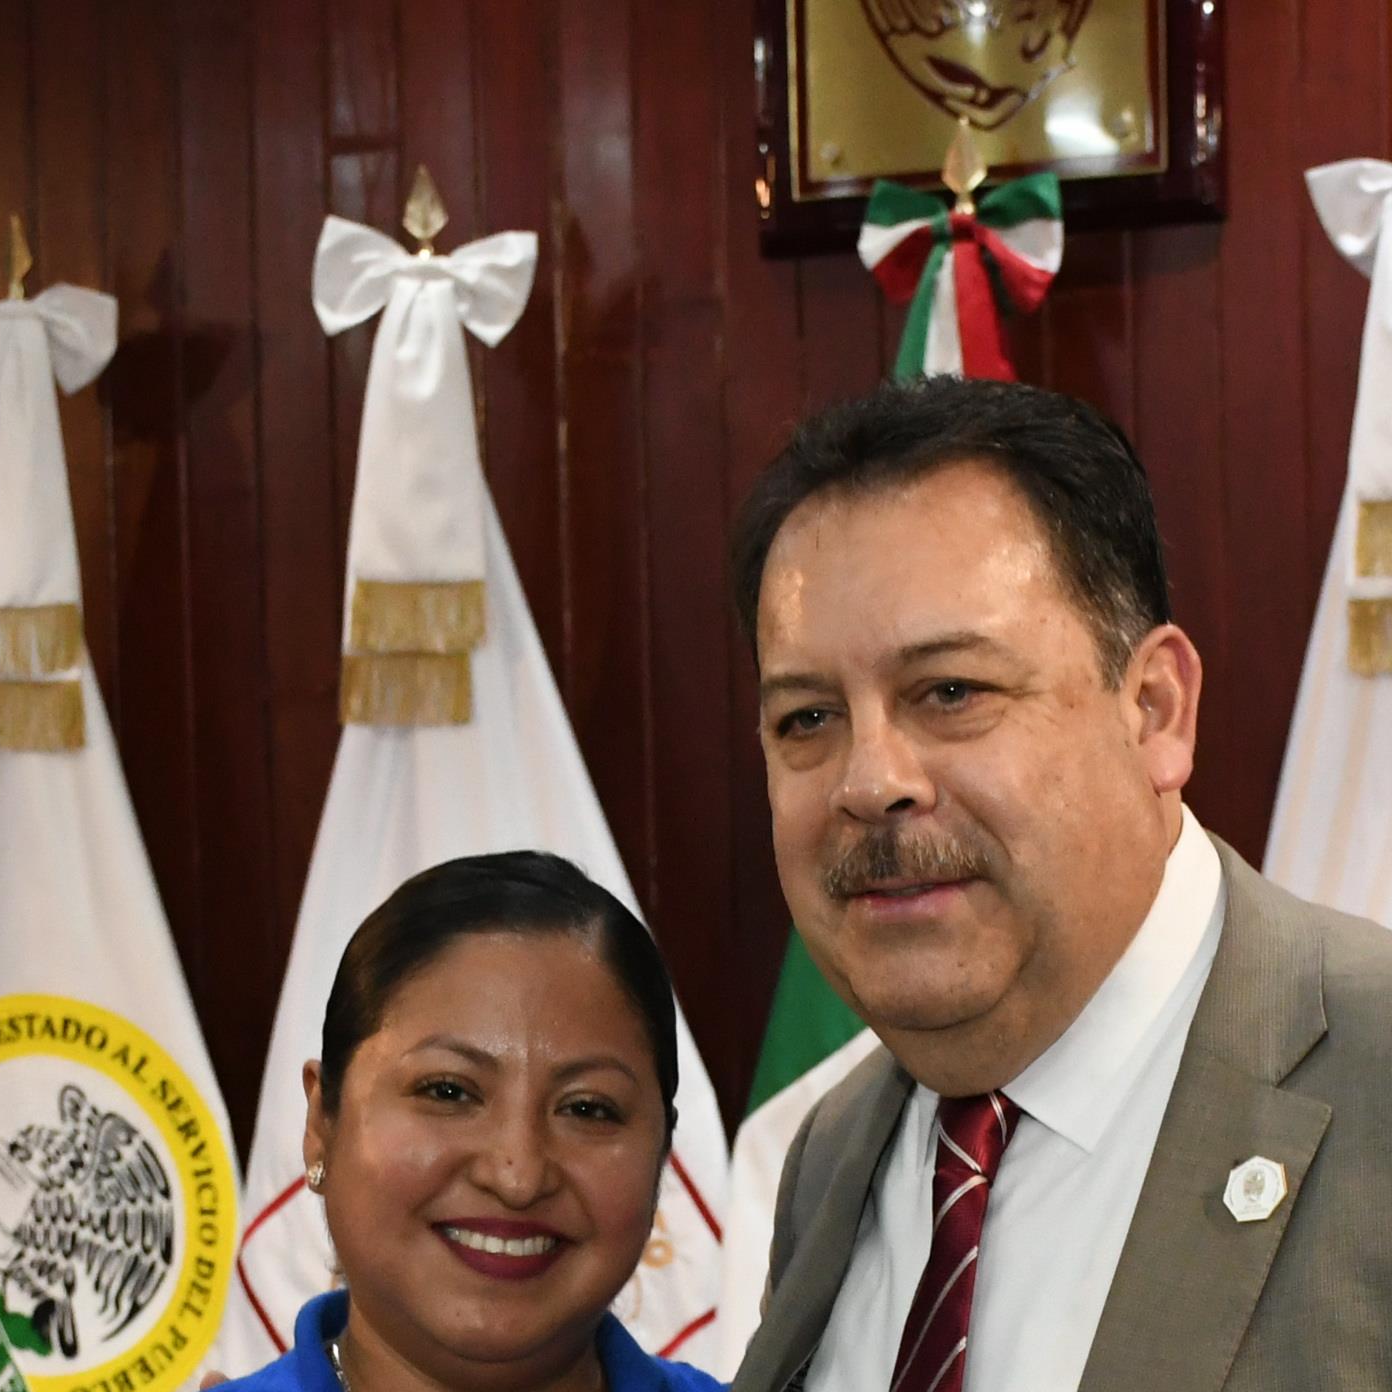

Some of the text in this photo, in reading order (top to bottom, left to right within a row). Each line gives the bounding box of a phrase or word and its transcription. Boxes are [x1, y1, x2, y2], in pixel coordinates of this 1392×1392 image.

[111, 1044, 149, 1085] AL
[150, 1078, 219, 1247] SERVICIO
[180, 1254, 217, 1318] DEL
